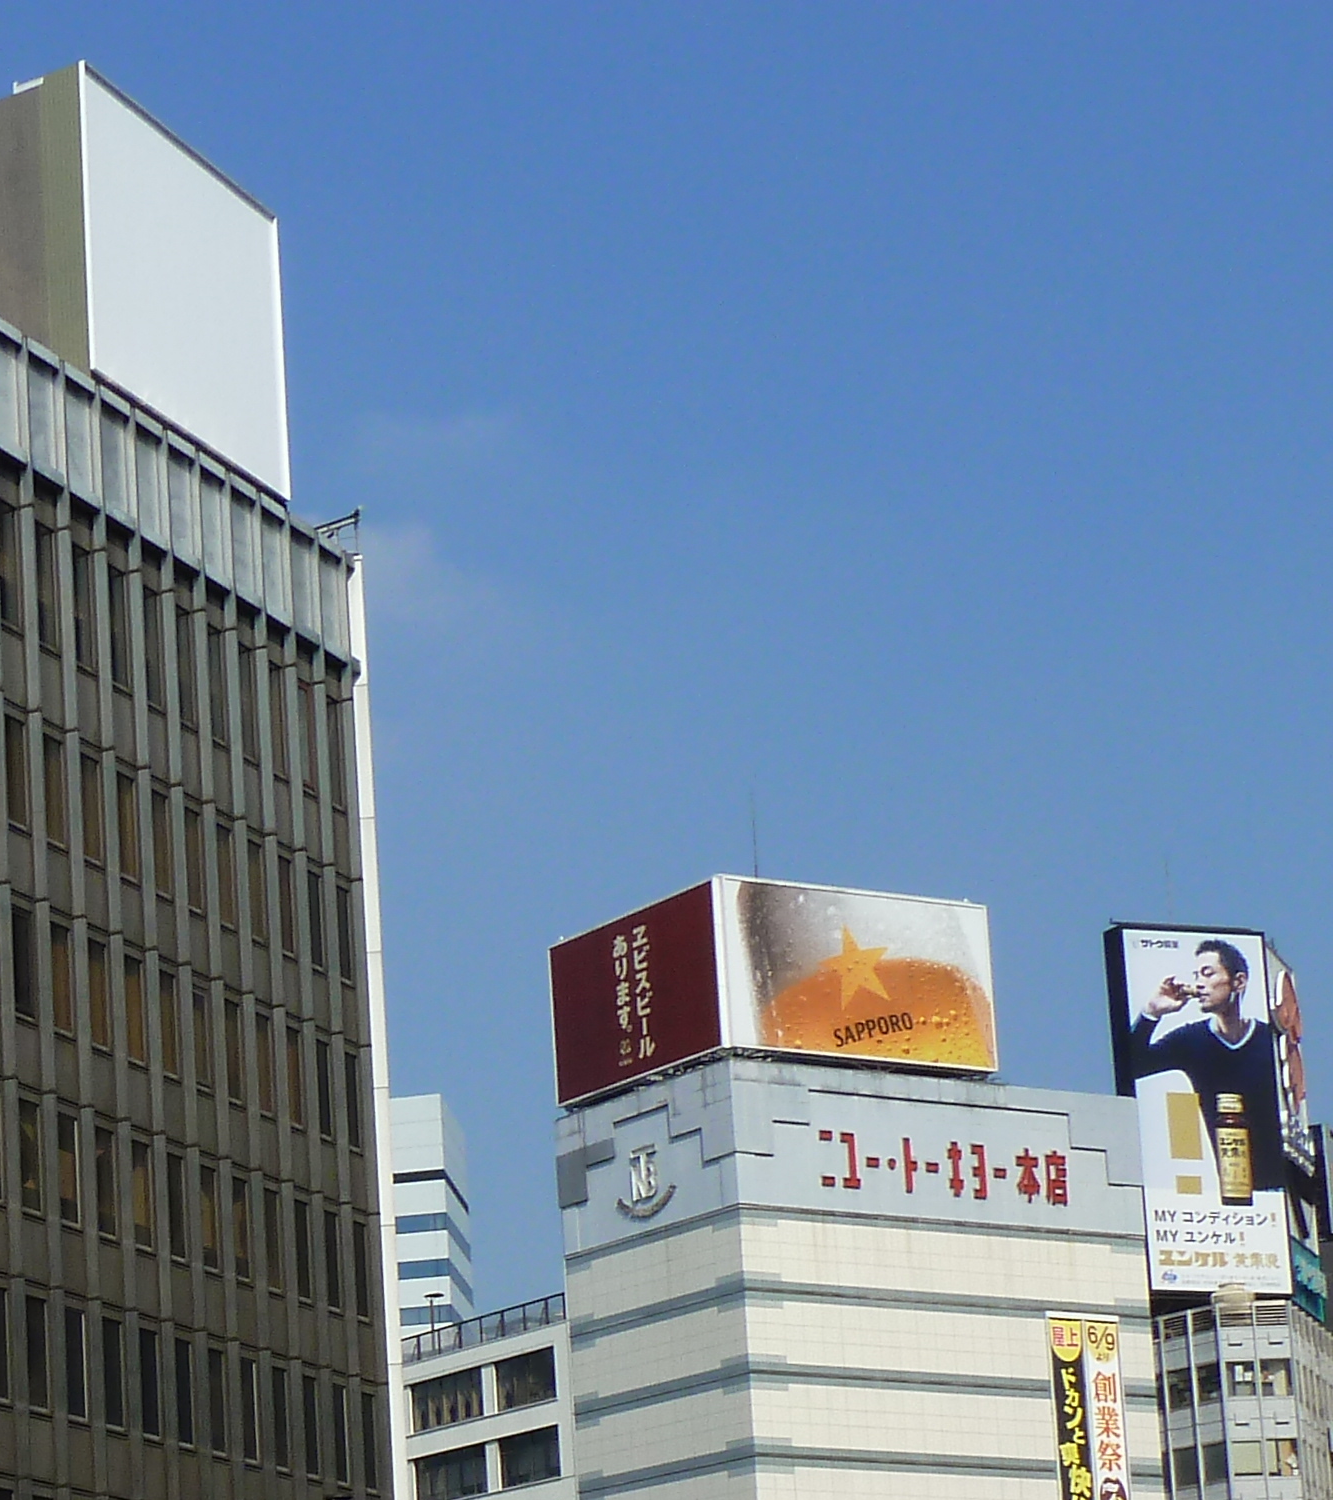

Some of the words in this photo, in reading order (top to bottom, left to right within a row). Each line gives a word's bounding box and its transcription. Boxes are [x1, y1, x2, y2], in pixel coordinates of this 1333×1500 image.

[612, 935, 633, 1033] あります。
[834, 1012, 914, 1048] SAPPORO
[1154, 1210, 1177, 1223] MY
[1156, 1230, 1179, 1243] MY
[1159, 1250, 1228, 1268] ユンケル
[1087, 1326, 1115, 1351] 6/9
[1092, 1371, 1122, 1471] 創業祭
